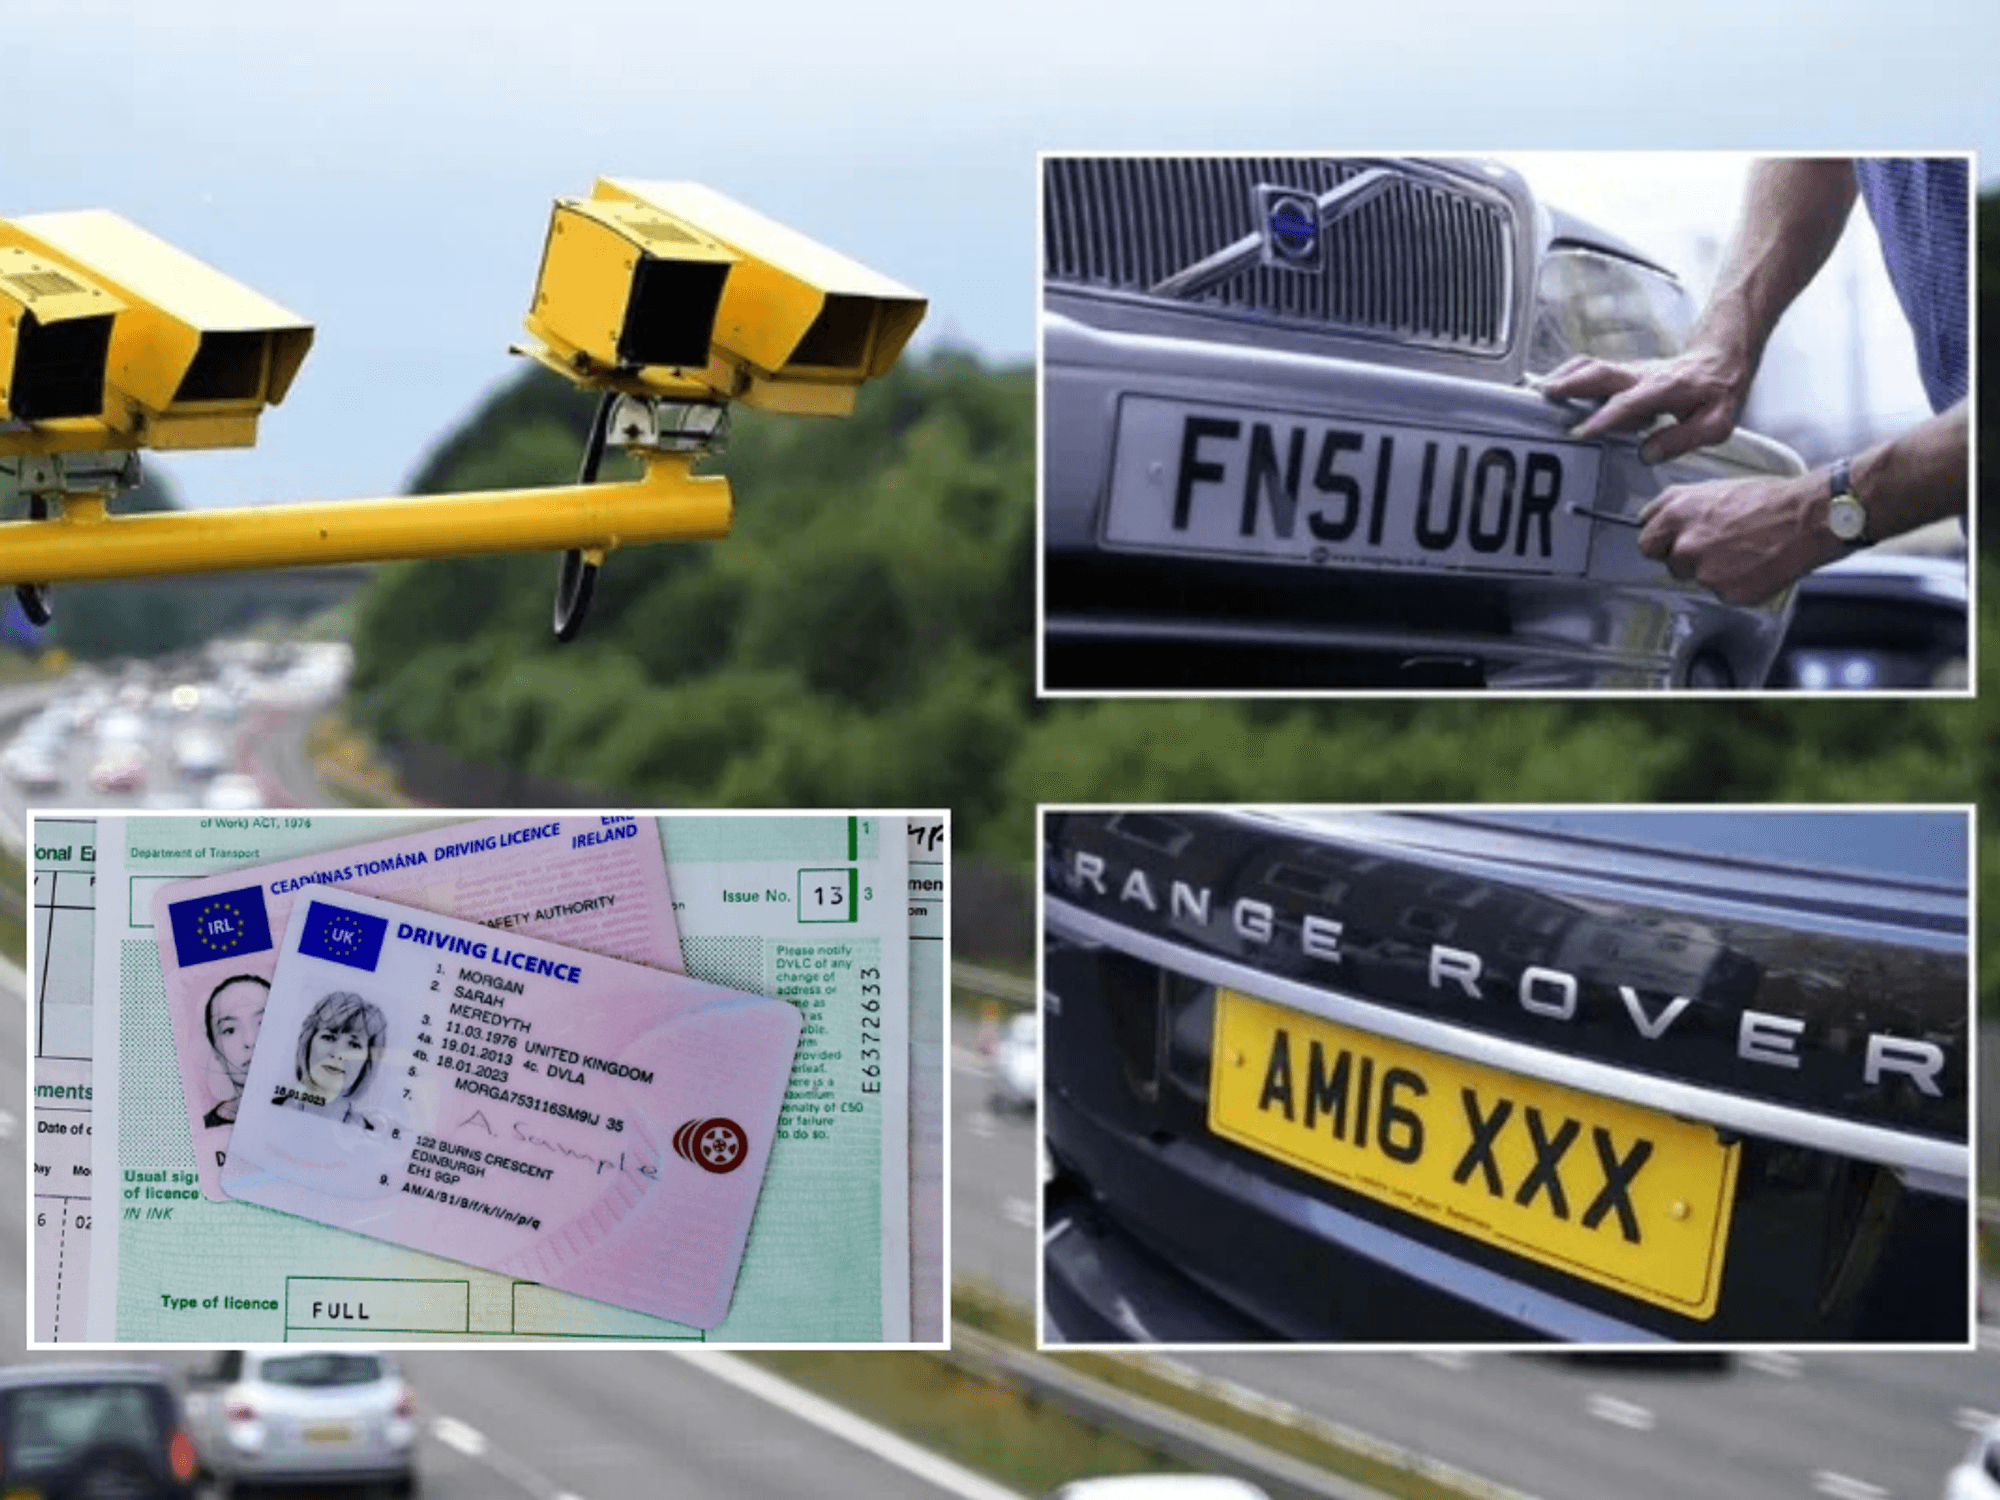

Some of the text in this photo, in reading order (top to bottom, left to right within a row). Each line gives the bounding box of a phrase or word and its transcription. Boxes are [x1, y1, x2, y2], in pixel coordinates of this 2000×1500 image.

[1171, 415, 1563, 557] FN51 UOR
[201, 817, 212, 829] of
[215, 817, 249, 830] Work)
[253, 817, 280, 830] ACT,
[572, 823, 638, 850] IRELAND
[130, 848, 260, 860] Department of Transport
[354, 851, 428, 878] TIOMÁNA
[434, 836, 497, 861] DRIVING
[499, 822, 561, 848] LICENCE
[723, 889, 791, 902] Issue No.
[814, 886, 873, 906] 13 3
[478, 894, 615, 929] AFETY AUTHORITY
[208, 918, 235, 935] IRL
[331, 927, 355, 944] UK
[397, 923, 582, 984] DRIVING LICENCE
[776, 944, 852, 956] Please notify
[776, 957, 852, 970] DVLC of any
[458, 967, 525, 995] MORGAN
[776, 971, 835, 983] change of
[1073, 848, 1948, 1097] RANGE ROVER
[454, 985, 506, 1008] SARAH
[777, 985, 837, 995] address or
[449, 1002, 532, 1034] MEREDYTH
[860, 967, 881, 1093] E6372633
[441, 1037, 513, 1066] 19.01.2013
[547, 1064, 586, 1085] DVLA
[446, 1020, 518, 1049] 11.03.1976
[524, 1040, 579, 1064] UNITED
[582, 1055, 655, 1085] KINGDOM
[436, 1054, 509, 1083] 18.01.2023
[34, 1084, 92, 1100] ments
[823, 1102, 835, 1112] of
[37, 1120, 67, 1135] Date
[70, 1122, 84, 1135] of
[605, 1117, 624, 1133] 35
[797, 1115, 834, 1126] failure
[793, 1129, 809, 1139] do
[812, 1130, 829, 1140] so.
[1257, 1028, 1653, 1246] AM16 XXX
[411, 1148, 486, 1178] EDINBURGH
[416, 1135, 437, 1150] 122
[438, 1141, 482, 1162] BURNS
[484, 1153, 554, 1181] CRESCENT
[124, 1169, 167, 1182] Usual
[407, 1162, 431, 1179] EH1
[124, 1186, 140, 1200] of
[124, 1207, 174, 1219] IN INK
[161, 1294, 279, 1311] Type of licence
[312, 1301, 370, 1320] FULL
